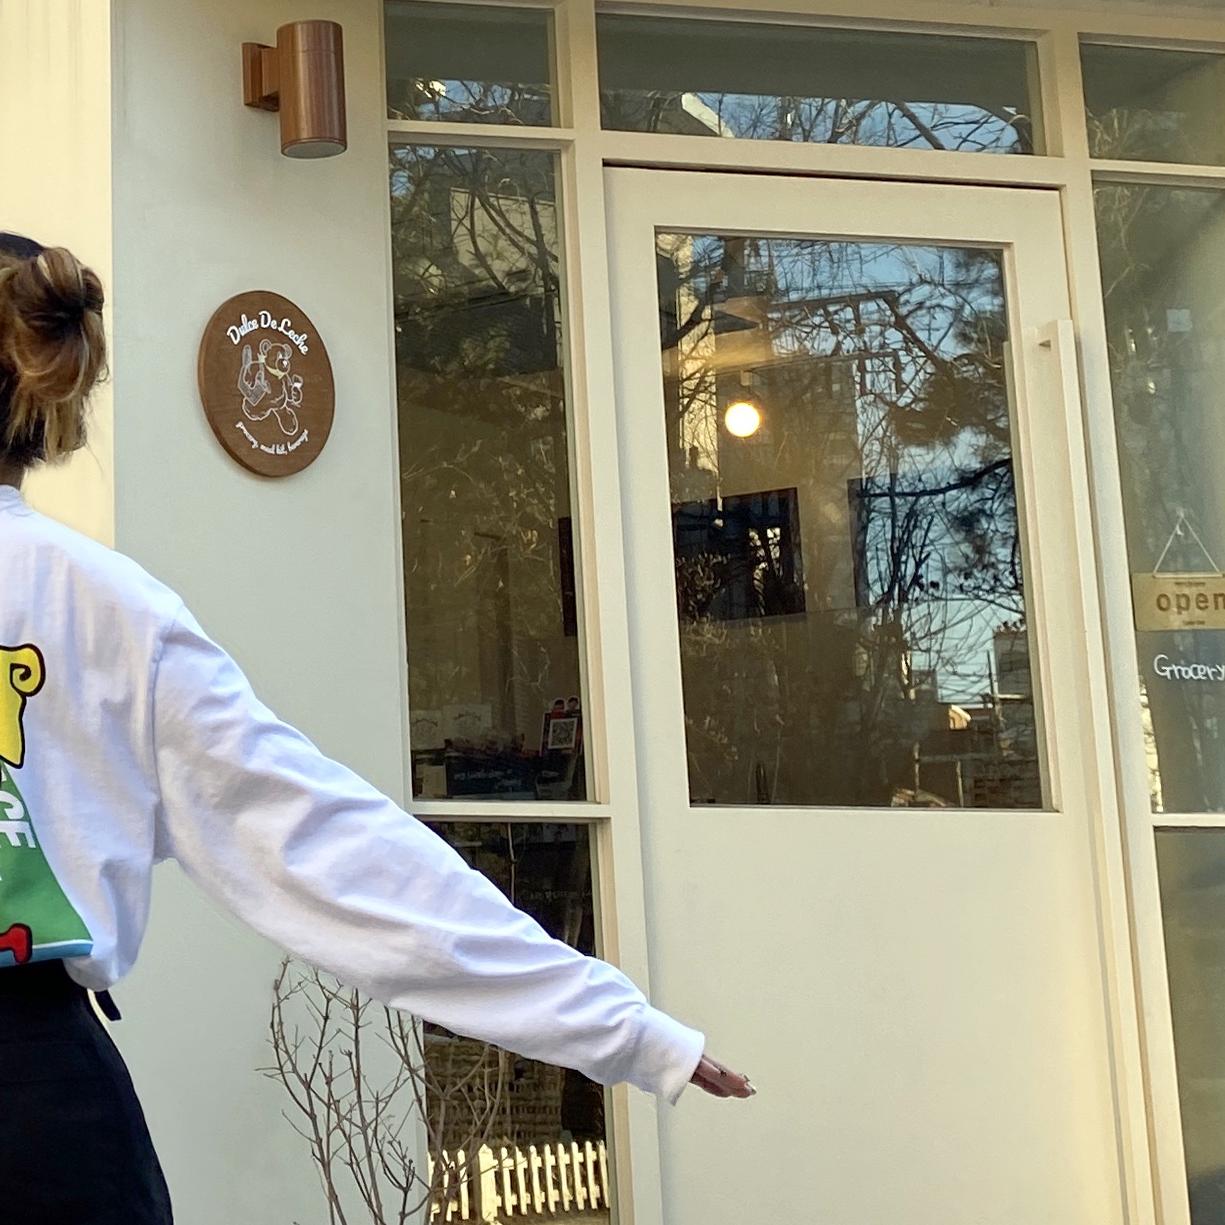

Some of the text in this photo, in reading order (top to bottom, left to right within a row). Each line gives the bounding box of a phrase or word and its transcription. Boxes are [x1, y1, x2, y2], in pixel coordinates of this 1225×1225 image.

[227, 310, 309, 355] Dulce De Leche
[1156, 592, 1225, 615] open
[1154, 654, 1225, 681] Grocery
